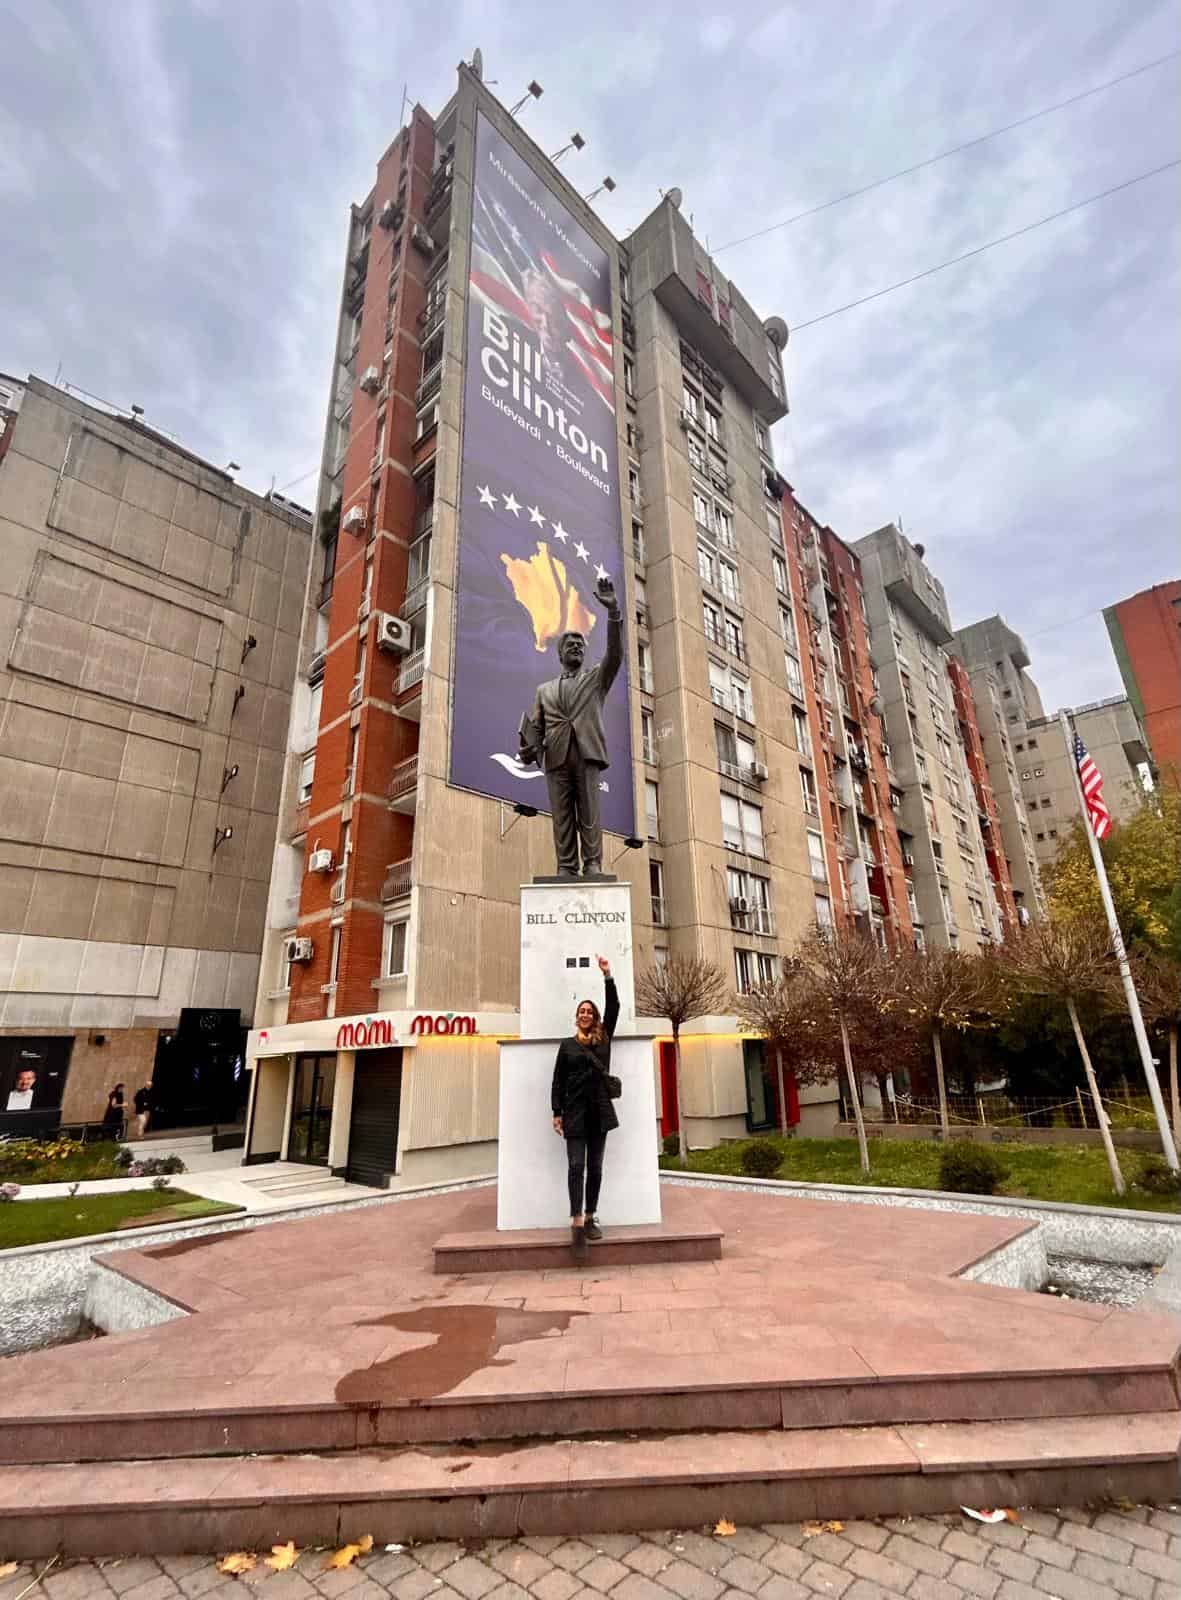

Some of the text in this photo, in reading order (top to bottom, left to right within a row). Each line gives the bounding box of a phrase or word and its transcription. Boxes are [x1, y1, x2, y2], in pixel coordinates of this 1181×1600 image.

[483, 303, 541, 383] Bill
[481, 346, 608, 473] Clinton
[481, 384, 542, 441] Bulevardi
[556, 444, 610, 497] Boulevard
[527, 911, 625, 925] BILL CLINTON
